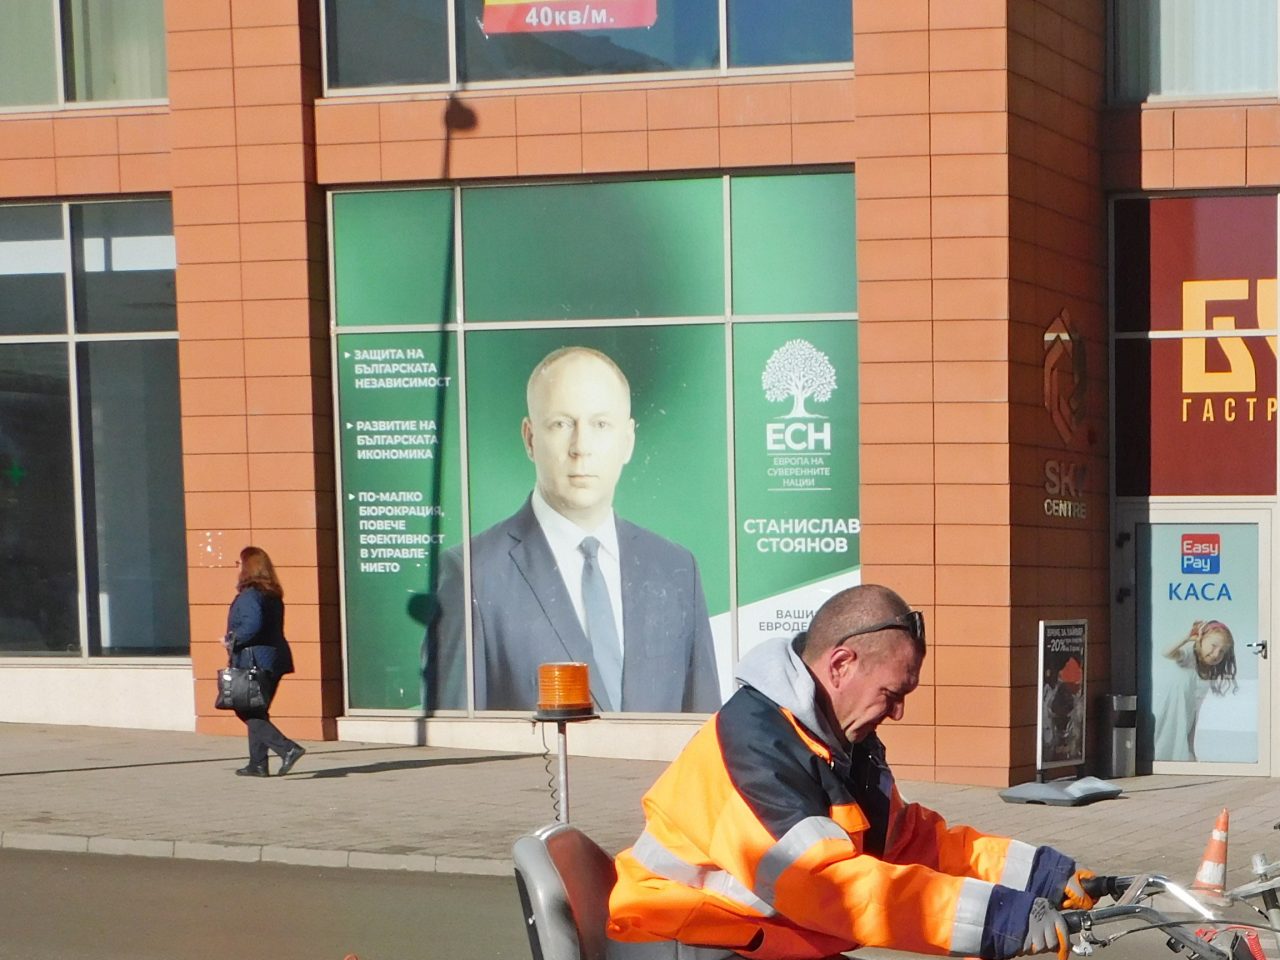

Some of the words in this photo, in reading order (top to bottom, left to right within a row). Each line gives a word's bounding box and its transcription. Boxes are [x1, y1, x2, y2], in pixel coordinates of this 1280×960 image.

[354, 349, 404, 361] ЗАЩИТА
[407, 348, 424, 359] НА
[354, 363, 437, 375] БЪЛГАРСКАТА
[355, 377, 451, 389] НЕЗАВИСИМОСТ
[356, 420, 417, 431] РАЗВИТИЕ
[419, 420, 437, 430] НА
[356, 434, 438, 446] БЪЛГАРСКАТА
[766, 422, 831, 450] ЕСН
[357, 449, 433, 460] ИКОНОМИКА
[773, 457, 809, 465] ЕВРОПА
[811, 457, 824, 465] НА
[767, 467, 830, 476] СУВЕРЕННИТЕ
[783, 478, 815, 488] НАЦИИ
[358, 491, 423, 502] ПО-МАЛКО
[1044, 499, 1087, 519] CENTRE
[359, 519, 406, 531] ПОВЕЧЕ
[743, 518, 861, 534] СТАНИСЛАВ
[359, 533, 445, 545] ЕФЕКТИВНОСТ
[757, 537, 848, 553] СТОЯНОВ
[360, 548, 369, 558] В
[1183, 540, 1218, 556] Easy
[360, 562, 400, 573] НИЕТО
[1183, 556, 1211, 572] Pay
[1168, 582, 1232, 601] КАСА
[776, 609, 816, 619] ВАШИ
[759, 621, 808, 632] ЕВРОДЕ
